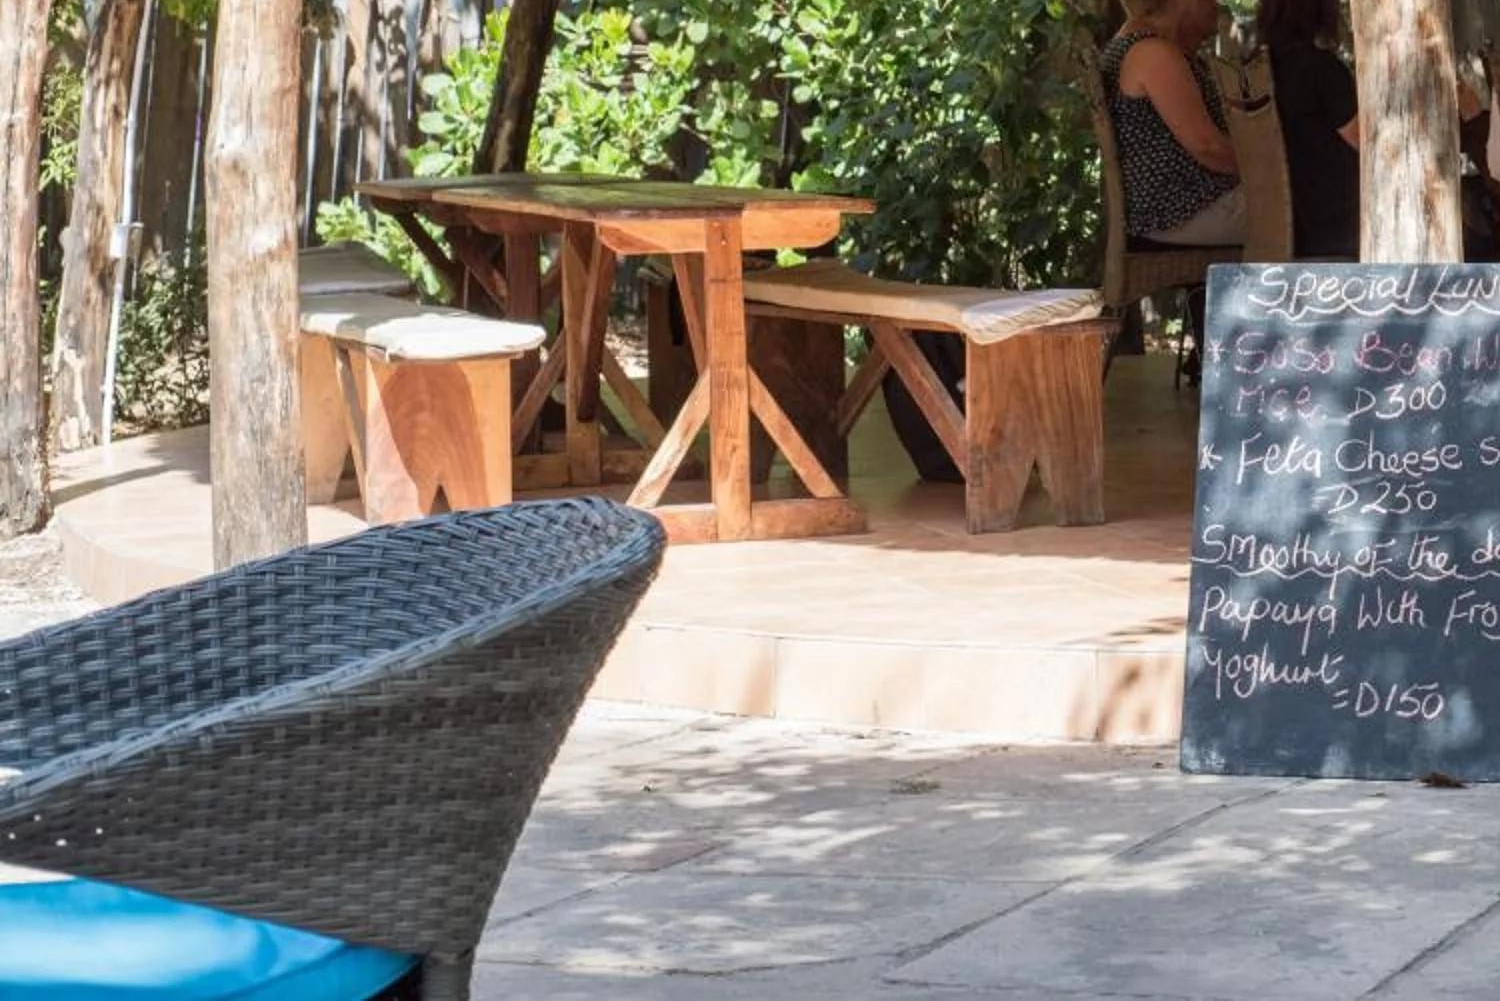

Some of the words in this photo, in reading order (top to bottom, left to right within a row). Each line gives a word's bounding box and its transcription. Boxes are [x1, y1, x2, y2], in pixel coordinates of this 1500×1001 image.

[1247, 265, 1419, 315] Special
[1349, 380, 1447, 421] D300
[1235, 432, 1322, 486] Feta
[1335, 429, 1464, 478] Cheese
[1198, 585, 1339, 656] Papaya
